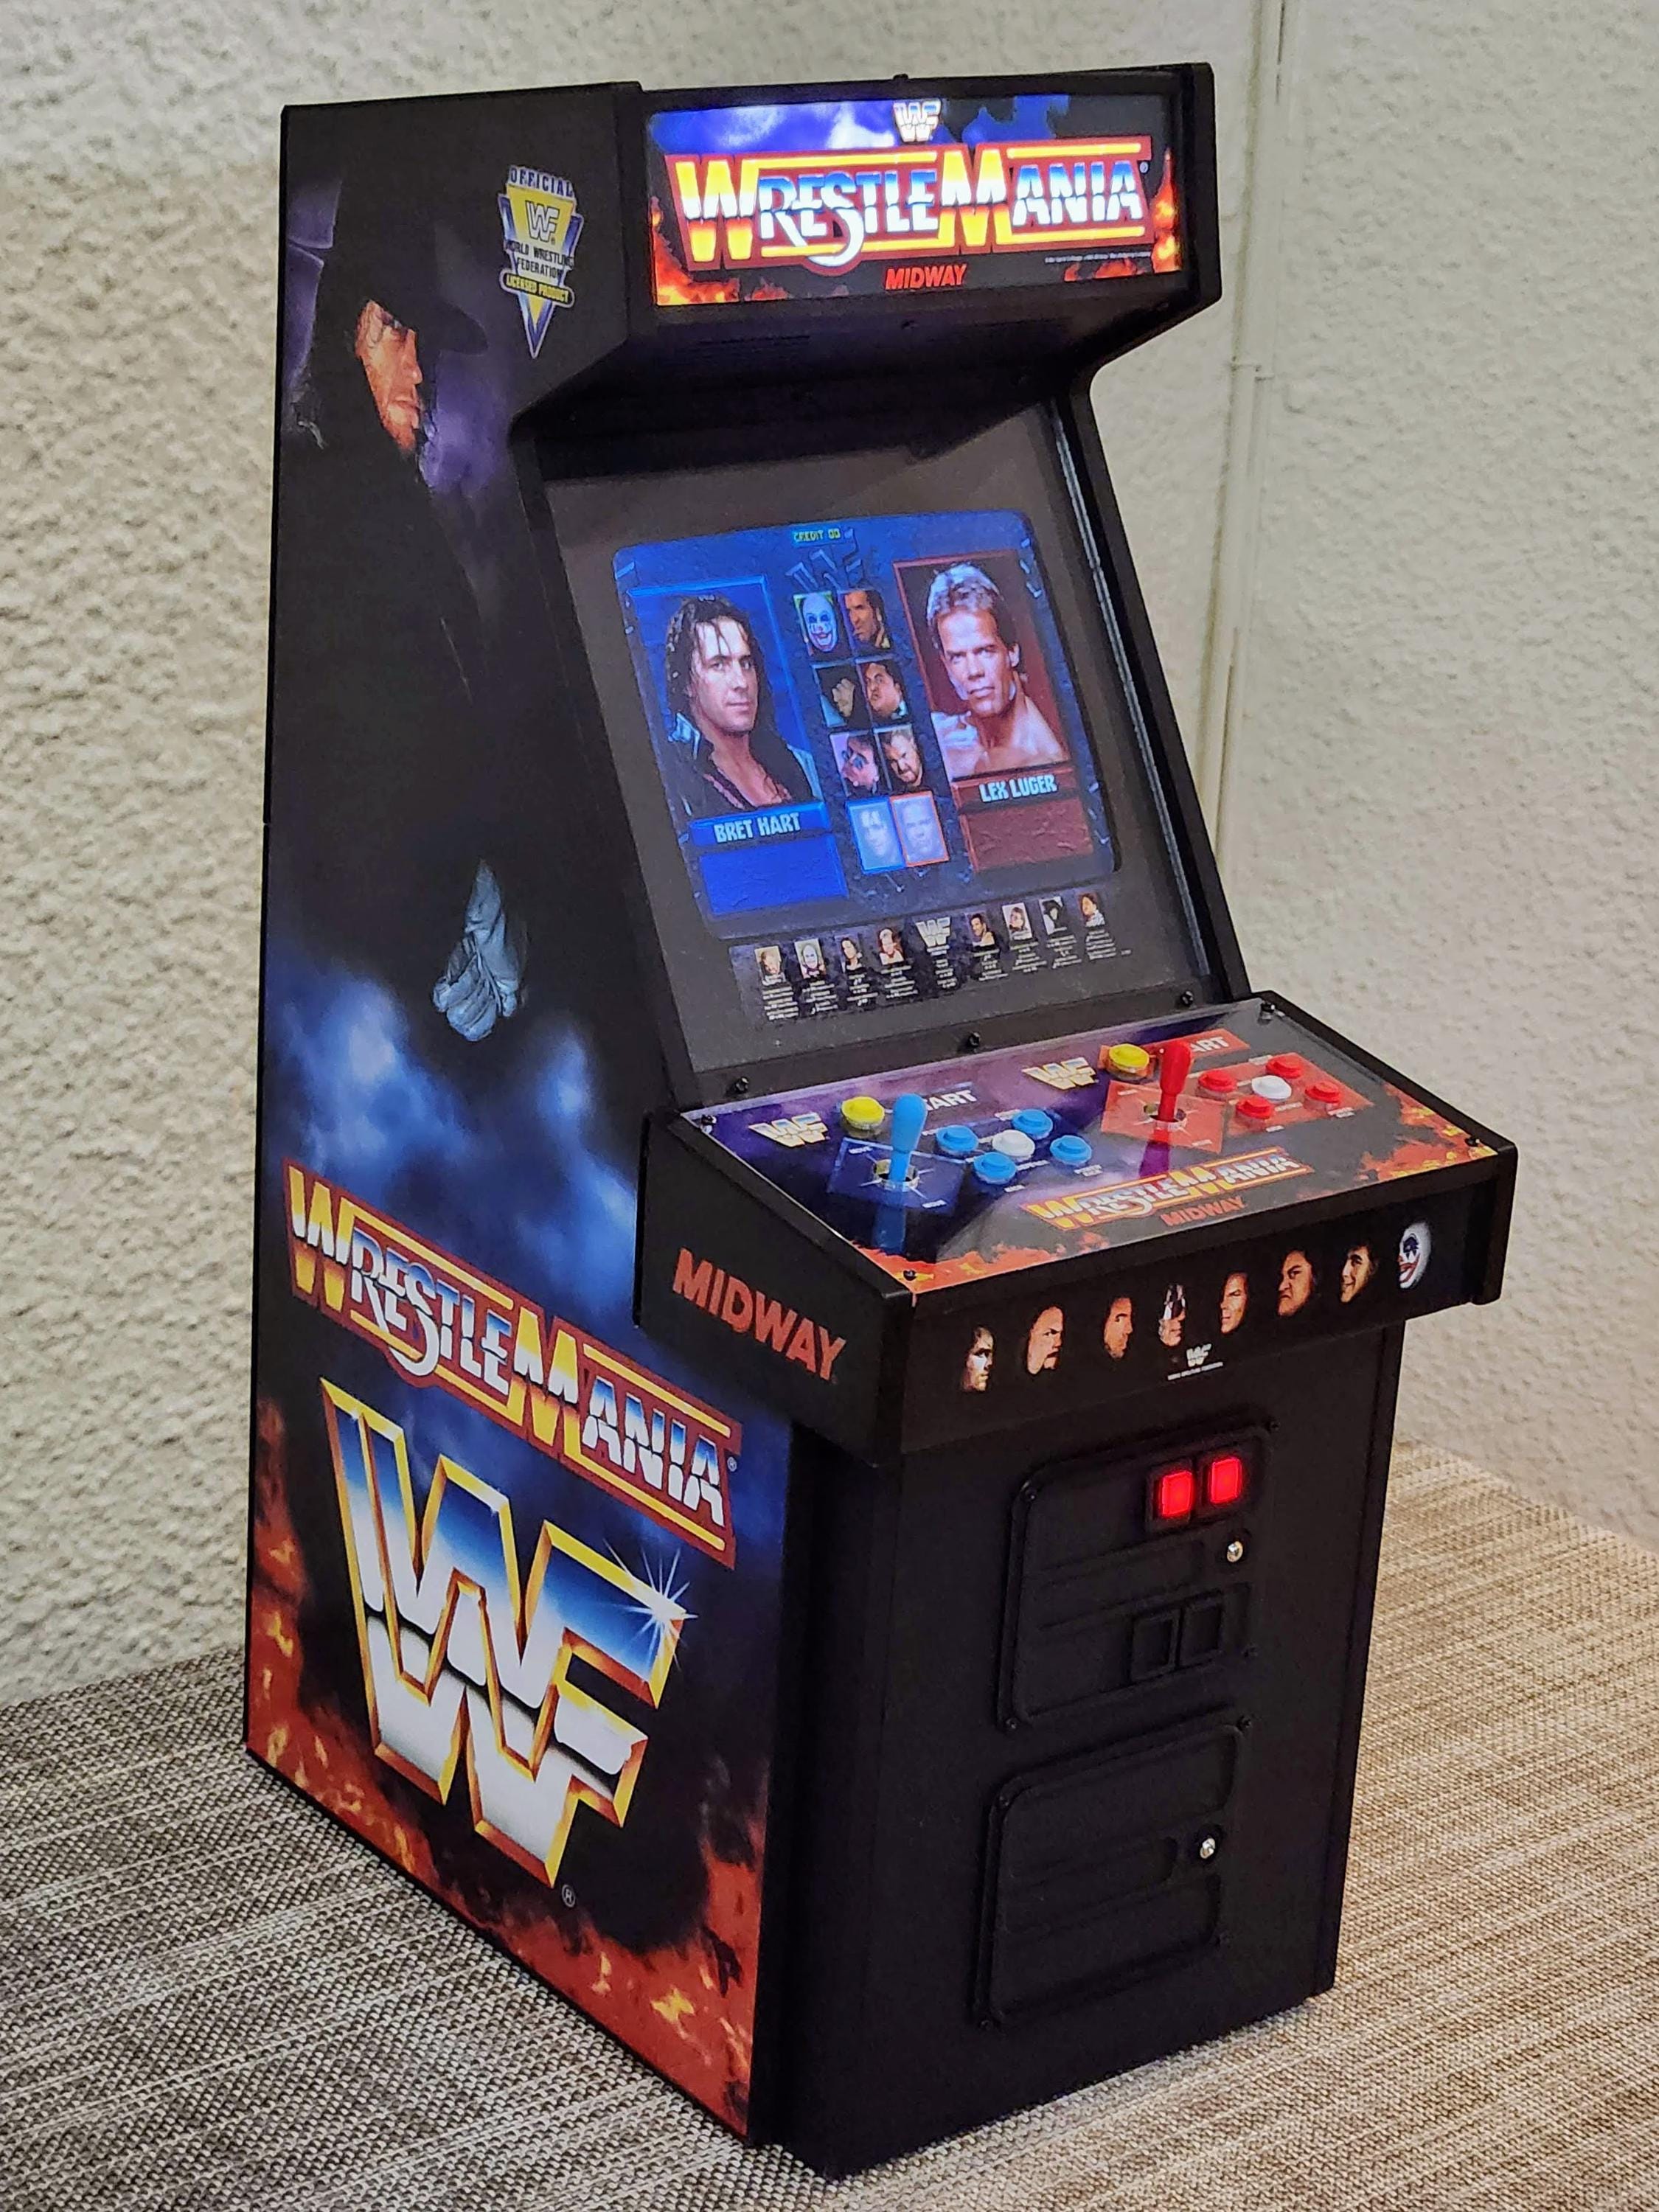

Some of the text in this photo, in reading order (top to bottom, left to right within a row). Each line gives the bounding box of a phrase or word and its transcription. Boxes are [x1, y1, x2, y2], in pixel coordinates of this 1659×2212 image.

[509, 167, 574, 198] OFFICIAL
[516, 257, 564, 278] FEDERATION
[886, 264, 967, 290] MIDWAY
[978, 774, 1058, 804] LEX LUGER
[713, 812, 802, 843] BRET HART
[922, 1090, 978, 1111] ART
[1161, 1197, 1245, 1226] MIDWAY
[672, 1248, 846, 1382] MIDWAY
